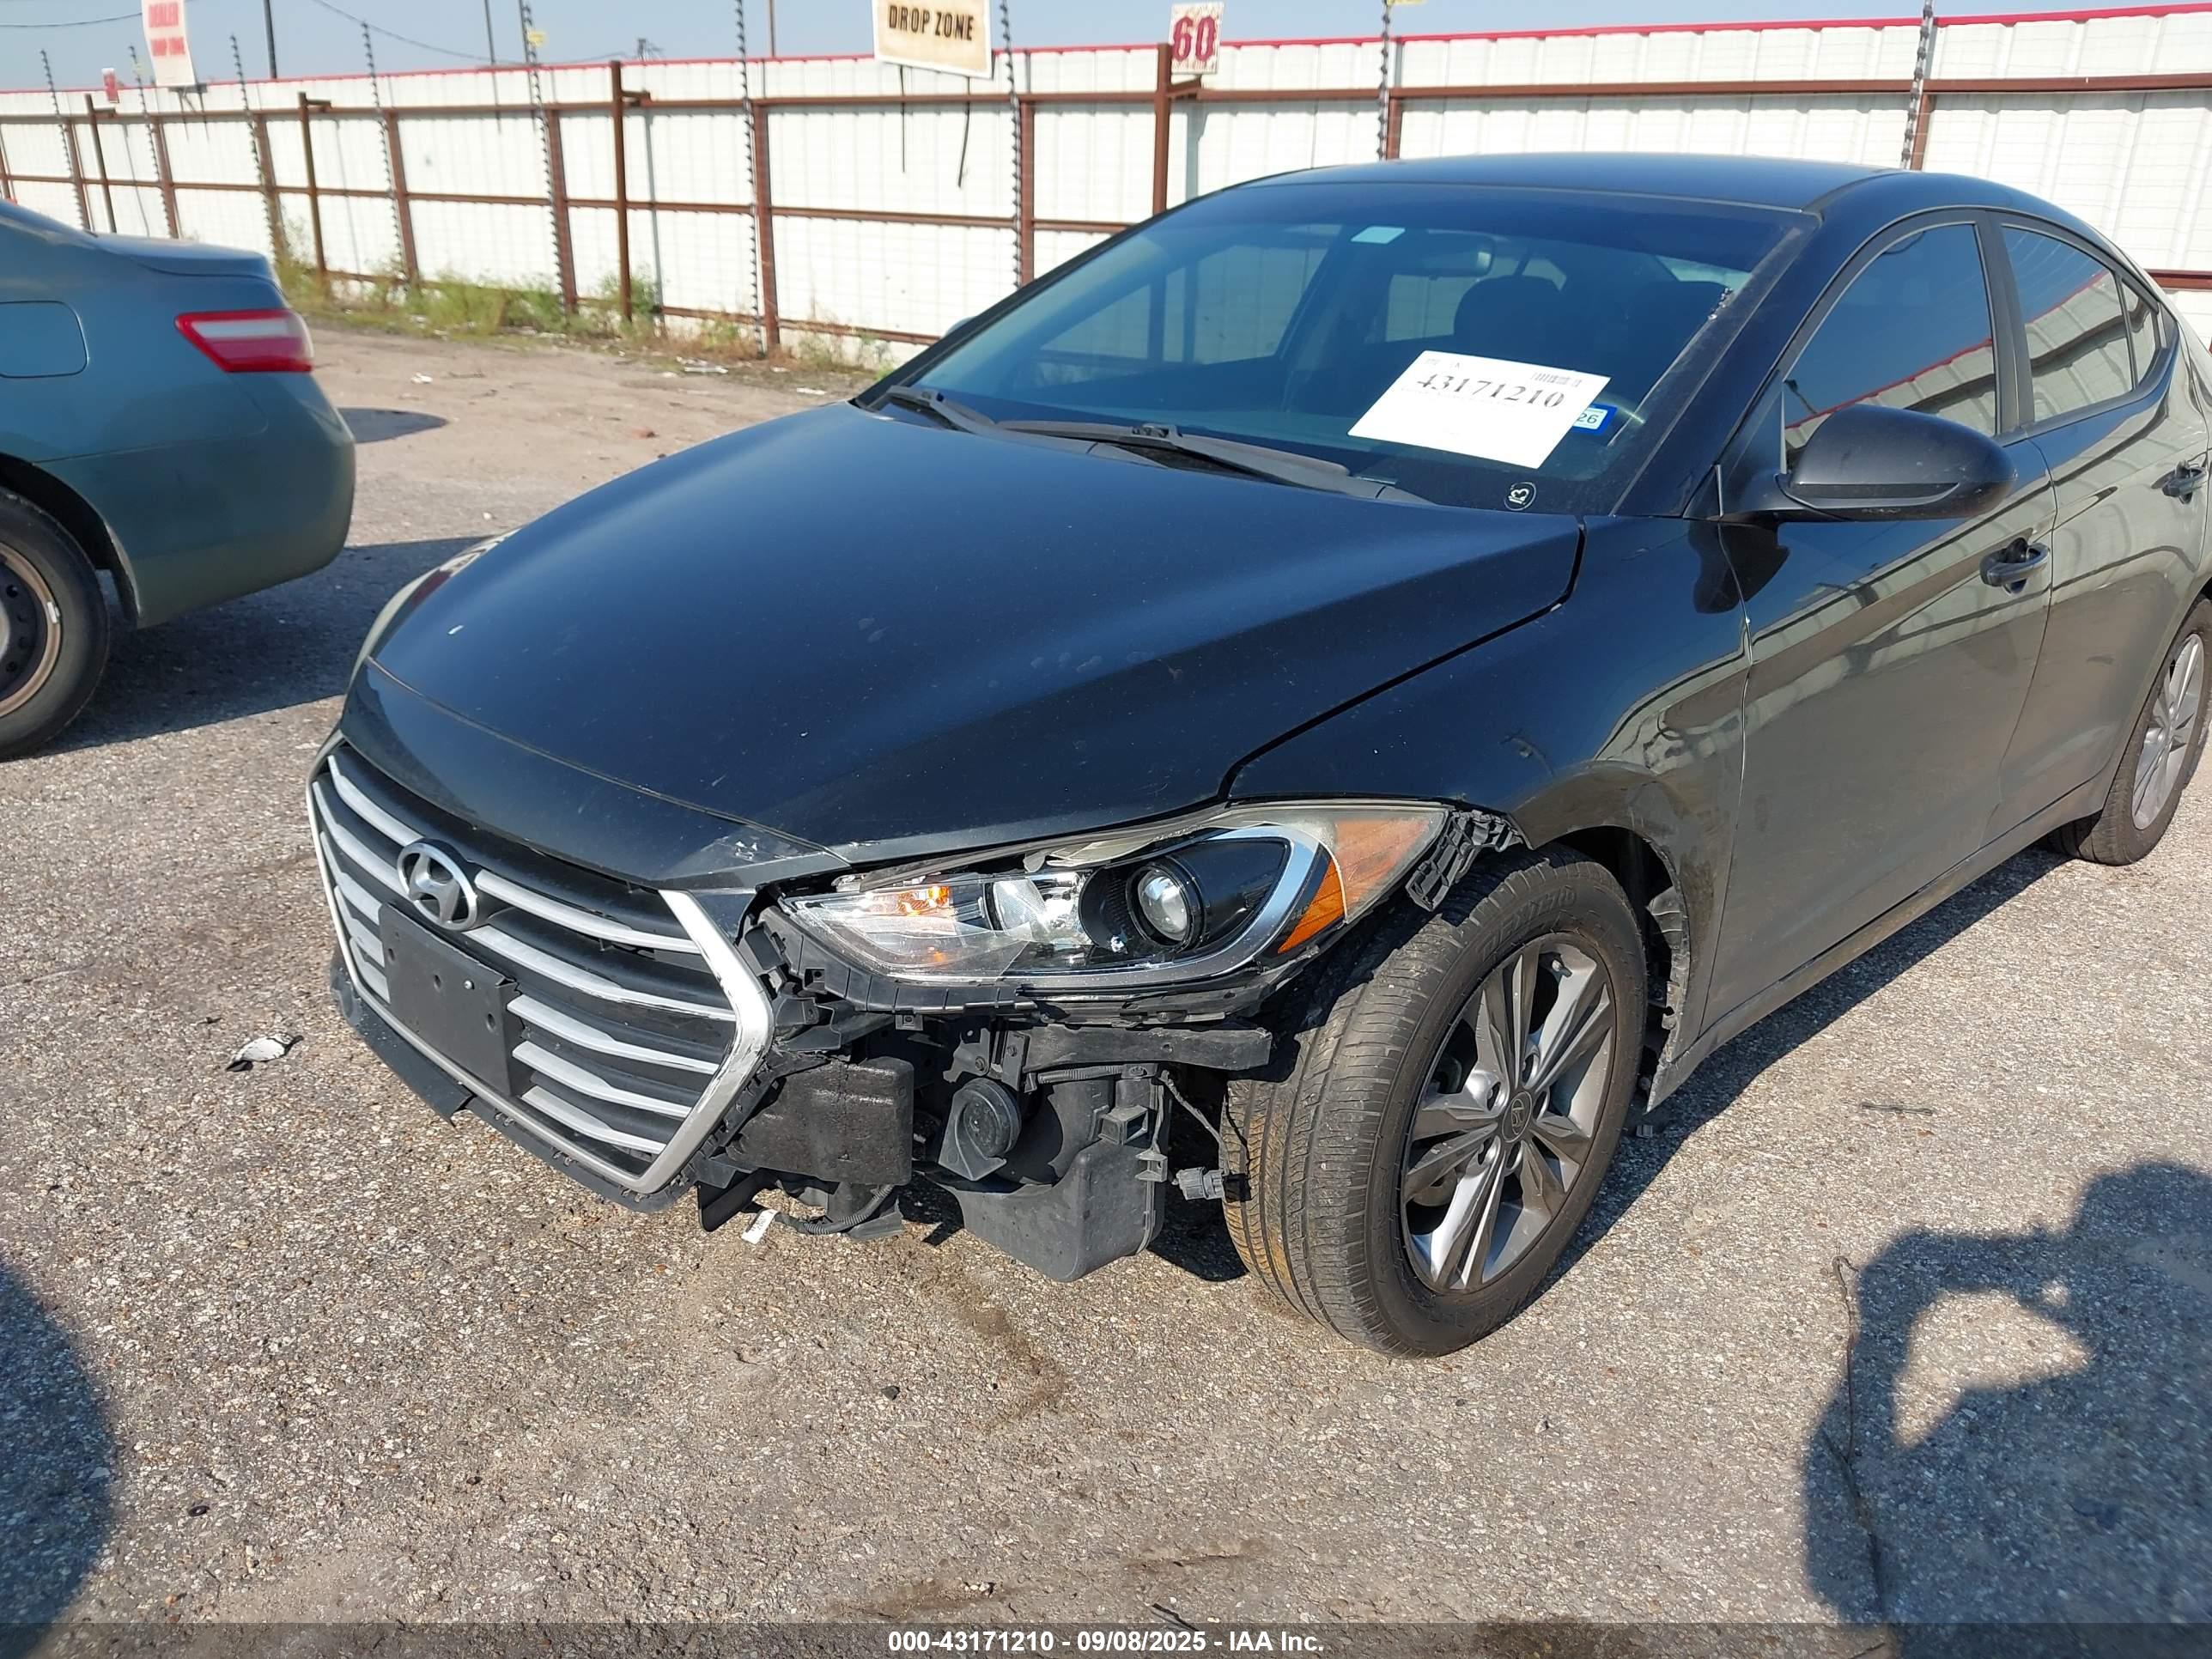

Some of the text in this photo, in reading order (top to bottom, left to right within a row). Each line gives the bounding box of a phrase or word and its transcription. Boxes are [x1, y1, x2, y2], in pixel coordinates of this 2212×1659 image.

[889, 4, 974, 41] DROP ZONE
[1172, 15, 1216, 62] 60
[1417, 374, 1565, 408] 43171210
